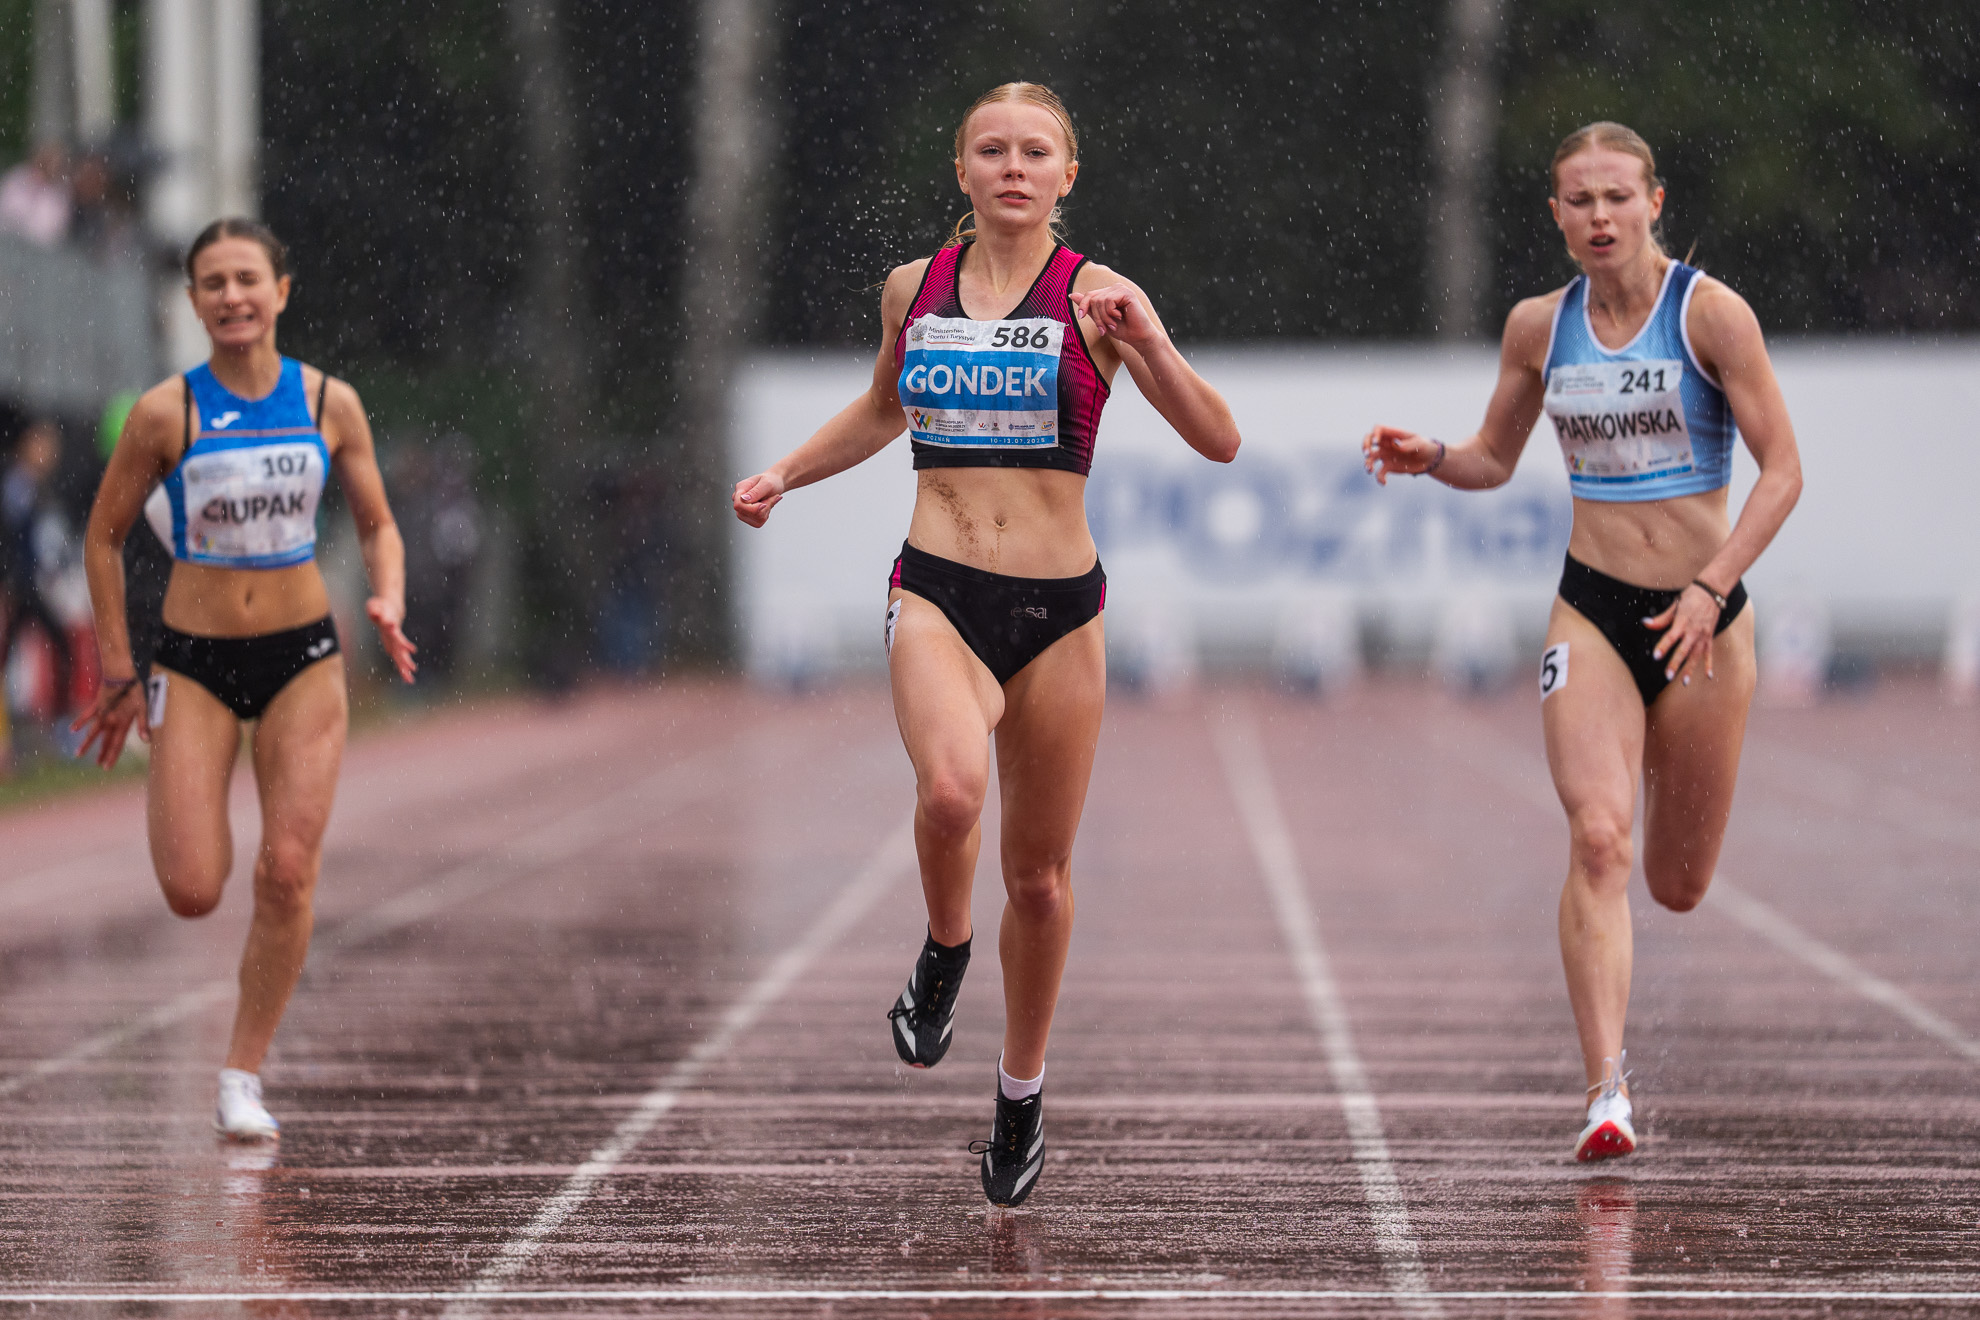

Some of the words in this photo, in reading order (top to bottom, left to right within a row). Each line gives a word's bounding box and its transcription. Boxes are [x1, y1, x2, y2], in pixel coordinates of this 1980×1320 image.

[991, 326, 1049, 349] 586
[905, 364, 1048, 397] GONDEK
[1619, 368, 1667, 394] 241
[926, 434, 951, 443] POZNAŃ
[263, 452, 308, 478] 107
[202, 490, 306, 524] CIUPAK
[1542, 648, 1558, 693] 5
